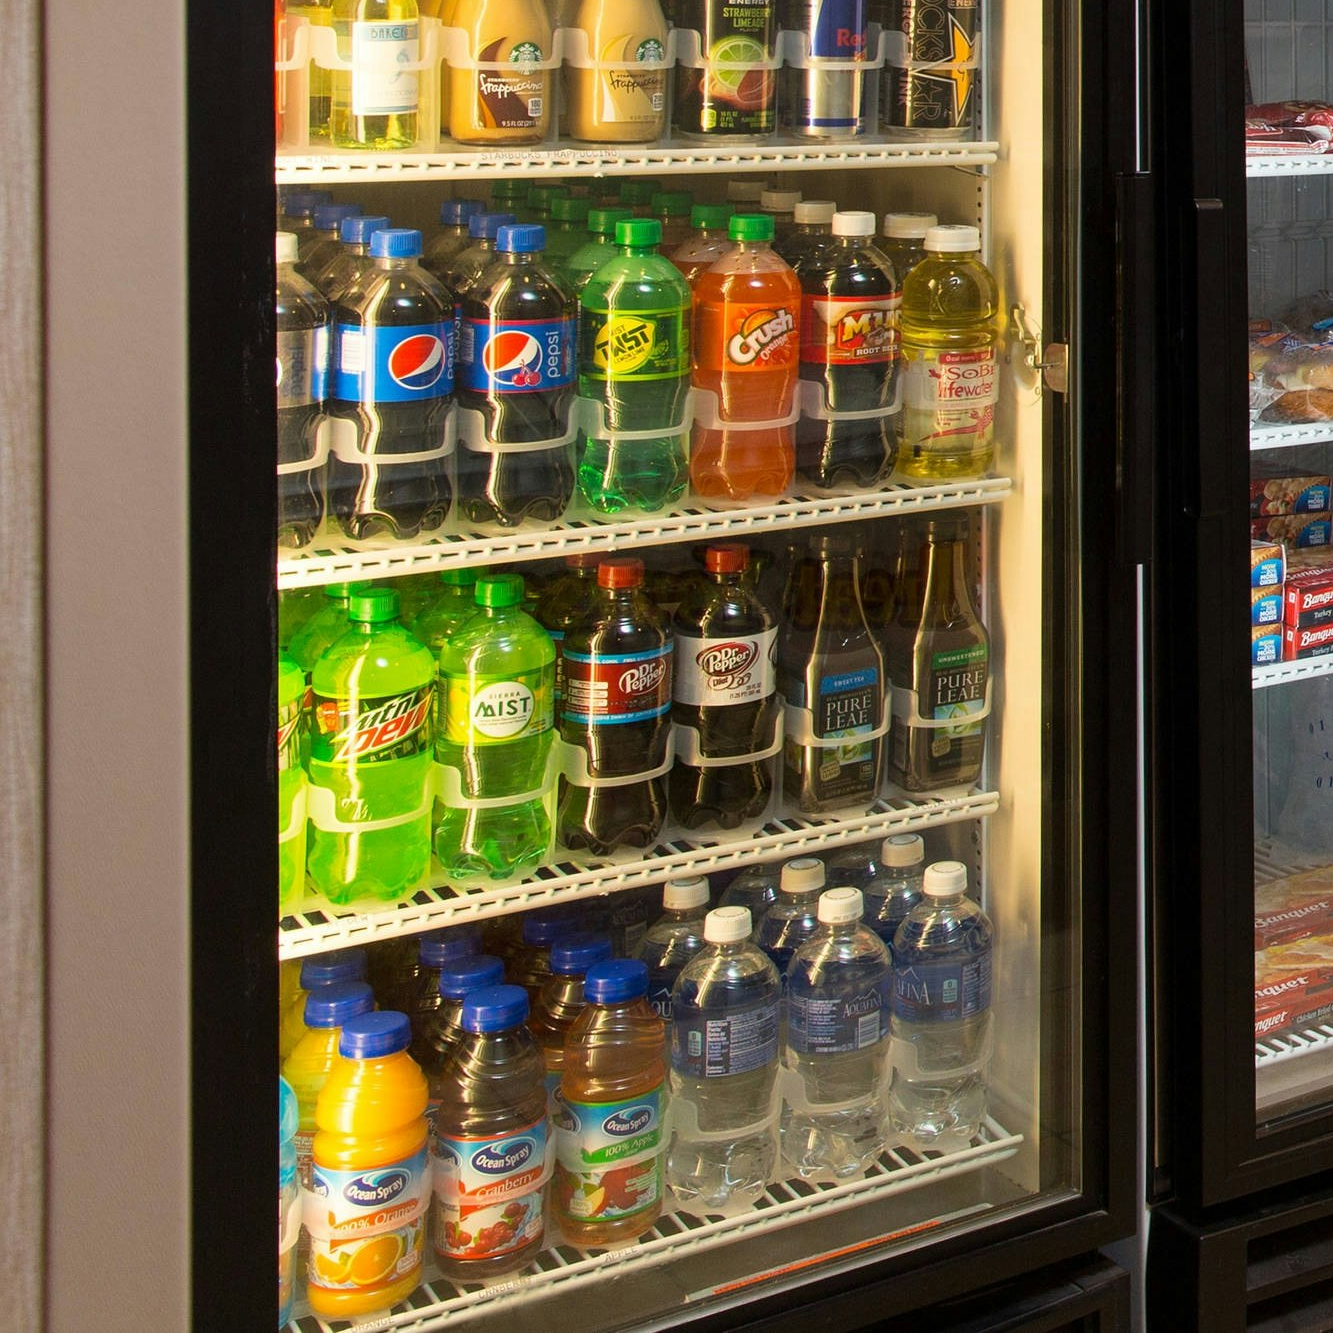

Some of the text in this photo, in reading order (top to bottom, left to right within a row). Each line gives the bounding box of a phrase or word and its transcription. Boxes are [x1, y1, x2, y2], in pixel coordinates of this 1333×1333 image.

[733, 18, 766, 27] LIMEADE
[728, 310, 795, 365] Crush
[546, 331, 561, 379] pepsi
[760, 334, 789, 362] Orange
[856, 347, 880, 357] ROOT
[1314, 606, 1332, 619] Turkey
[721, 647, 738, 661] Dr
[938, 650, 984, 663] UNSWEETENED
[1312, 644, 1330, 657] Turkey
[639, 663, 656, 678] Dr
[708, 650, 749, 674] Pepper
[625, 666, 664, 694] Pepper
[713, 676, 729, 687] Diet
[834, 676, 865, 688] SWEET TEA
[937, 670, 984, 690] PURE
[489, 691, 521, 700] SIERRA
[937, 684, 980, 705] LEAF
[474, 697, 530, 718] MIST
[826, 695, 872, 716] PURE
[826, 710, 869, 731] LEAF
[1254, 901, 1329, 930] Banquet
[607, 1113, 648, 1131] Ocean Spray
[476, 1144, 530, 1169] Ocean Spray
[605, 1142, 629, 1157] 100%
[346, 1177, 404, 1200] Ocean Spray
[476, 1171, 534, 1203] Cranberry
